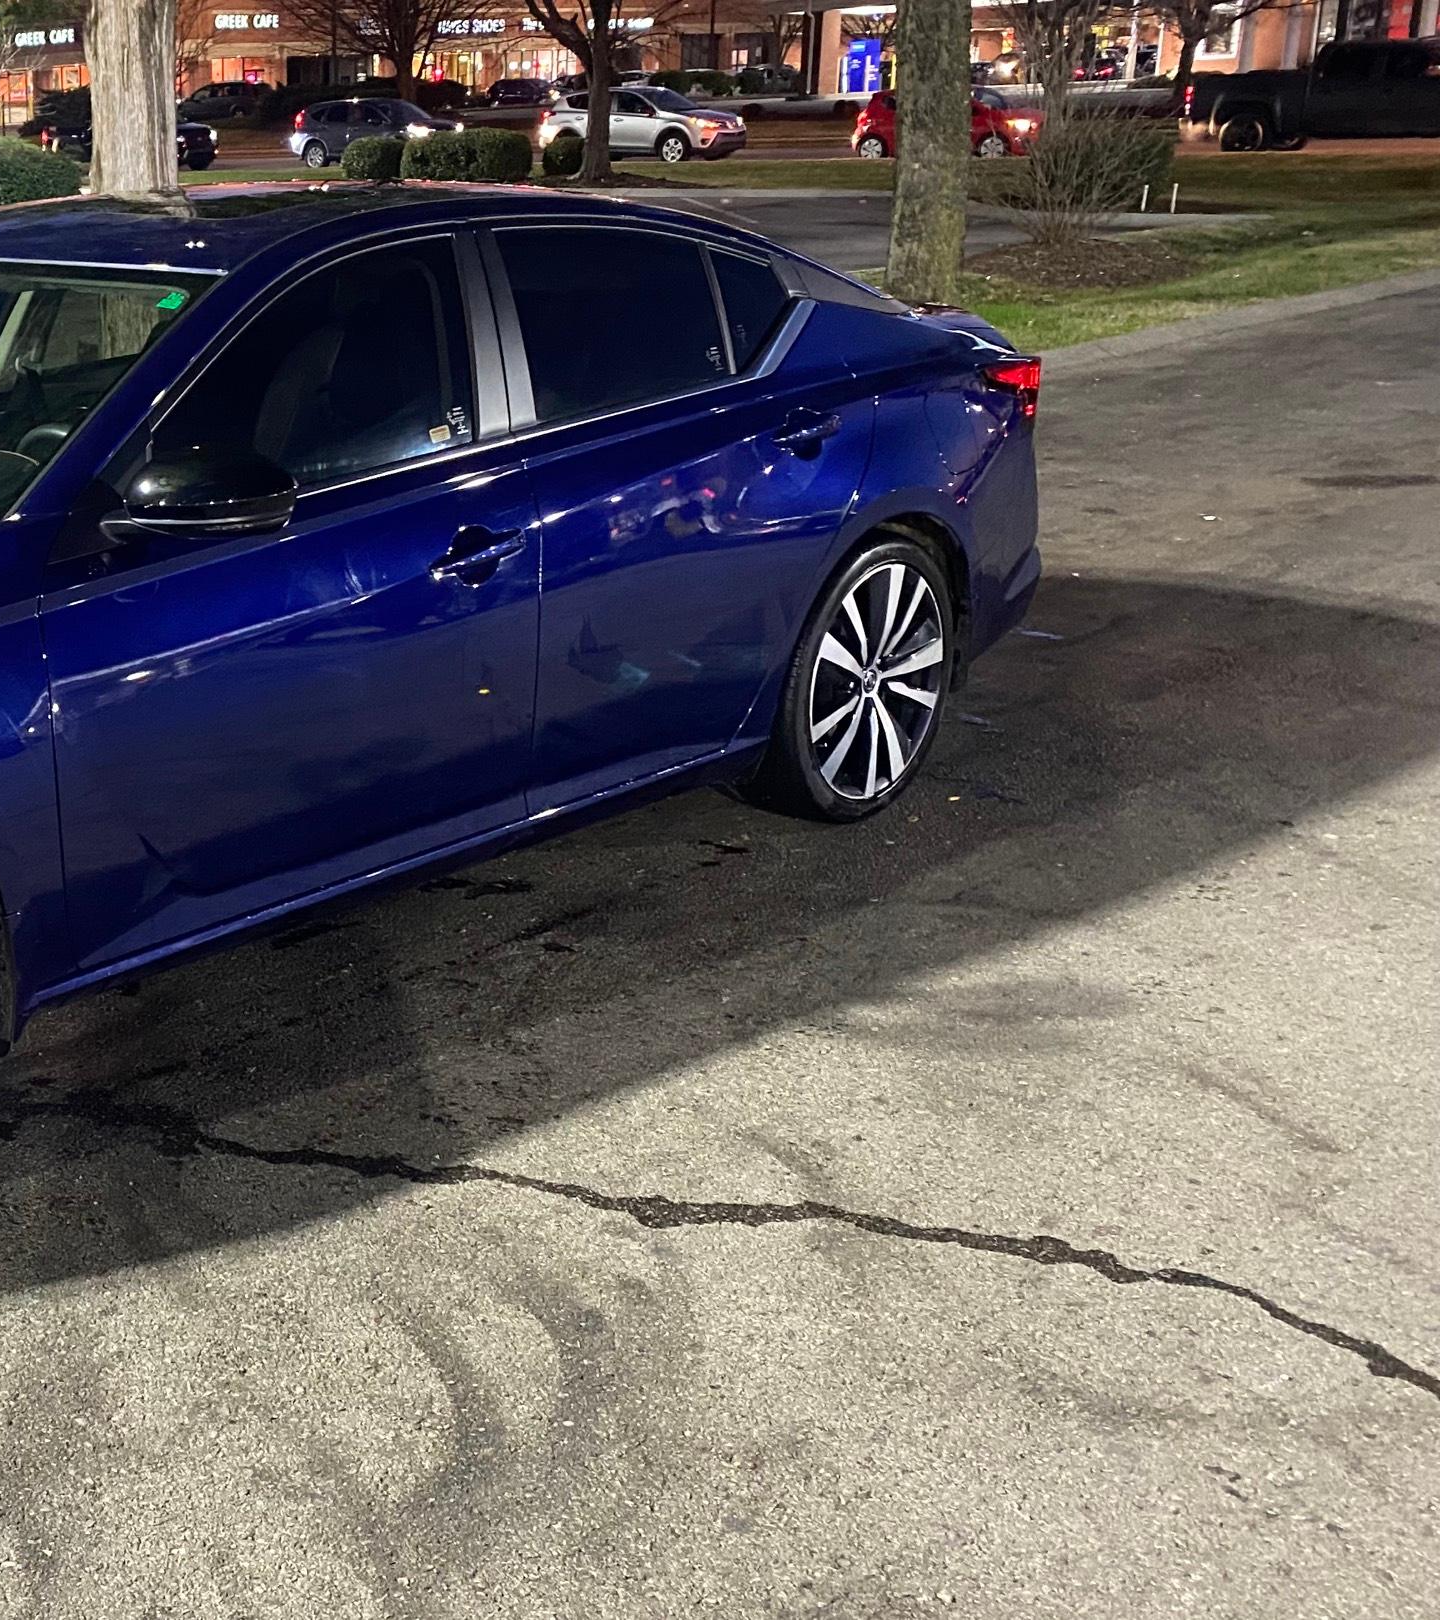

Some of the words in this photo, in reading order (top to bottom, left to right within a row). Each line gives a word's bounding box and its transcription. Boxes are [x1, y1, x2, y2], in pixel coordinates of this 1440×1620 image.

[214, 14, 249, 29] GREEK
[252, 14, 279, 29] CAFE
[472, 18, 506, 33] SHOES
[14, 30, 46, 47] GREEK
[48, 28, 75, 45] CAFE
